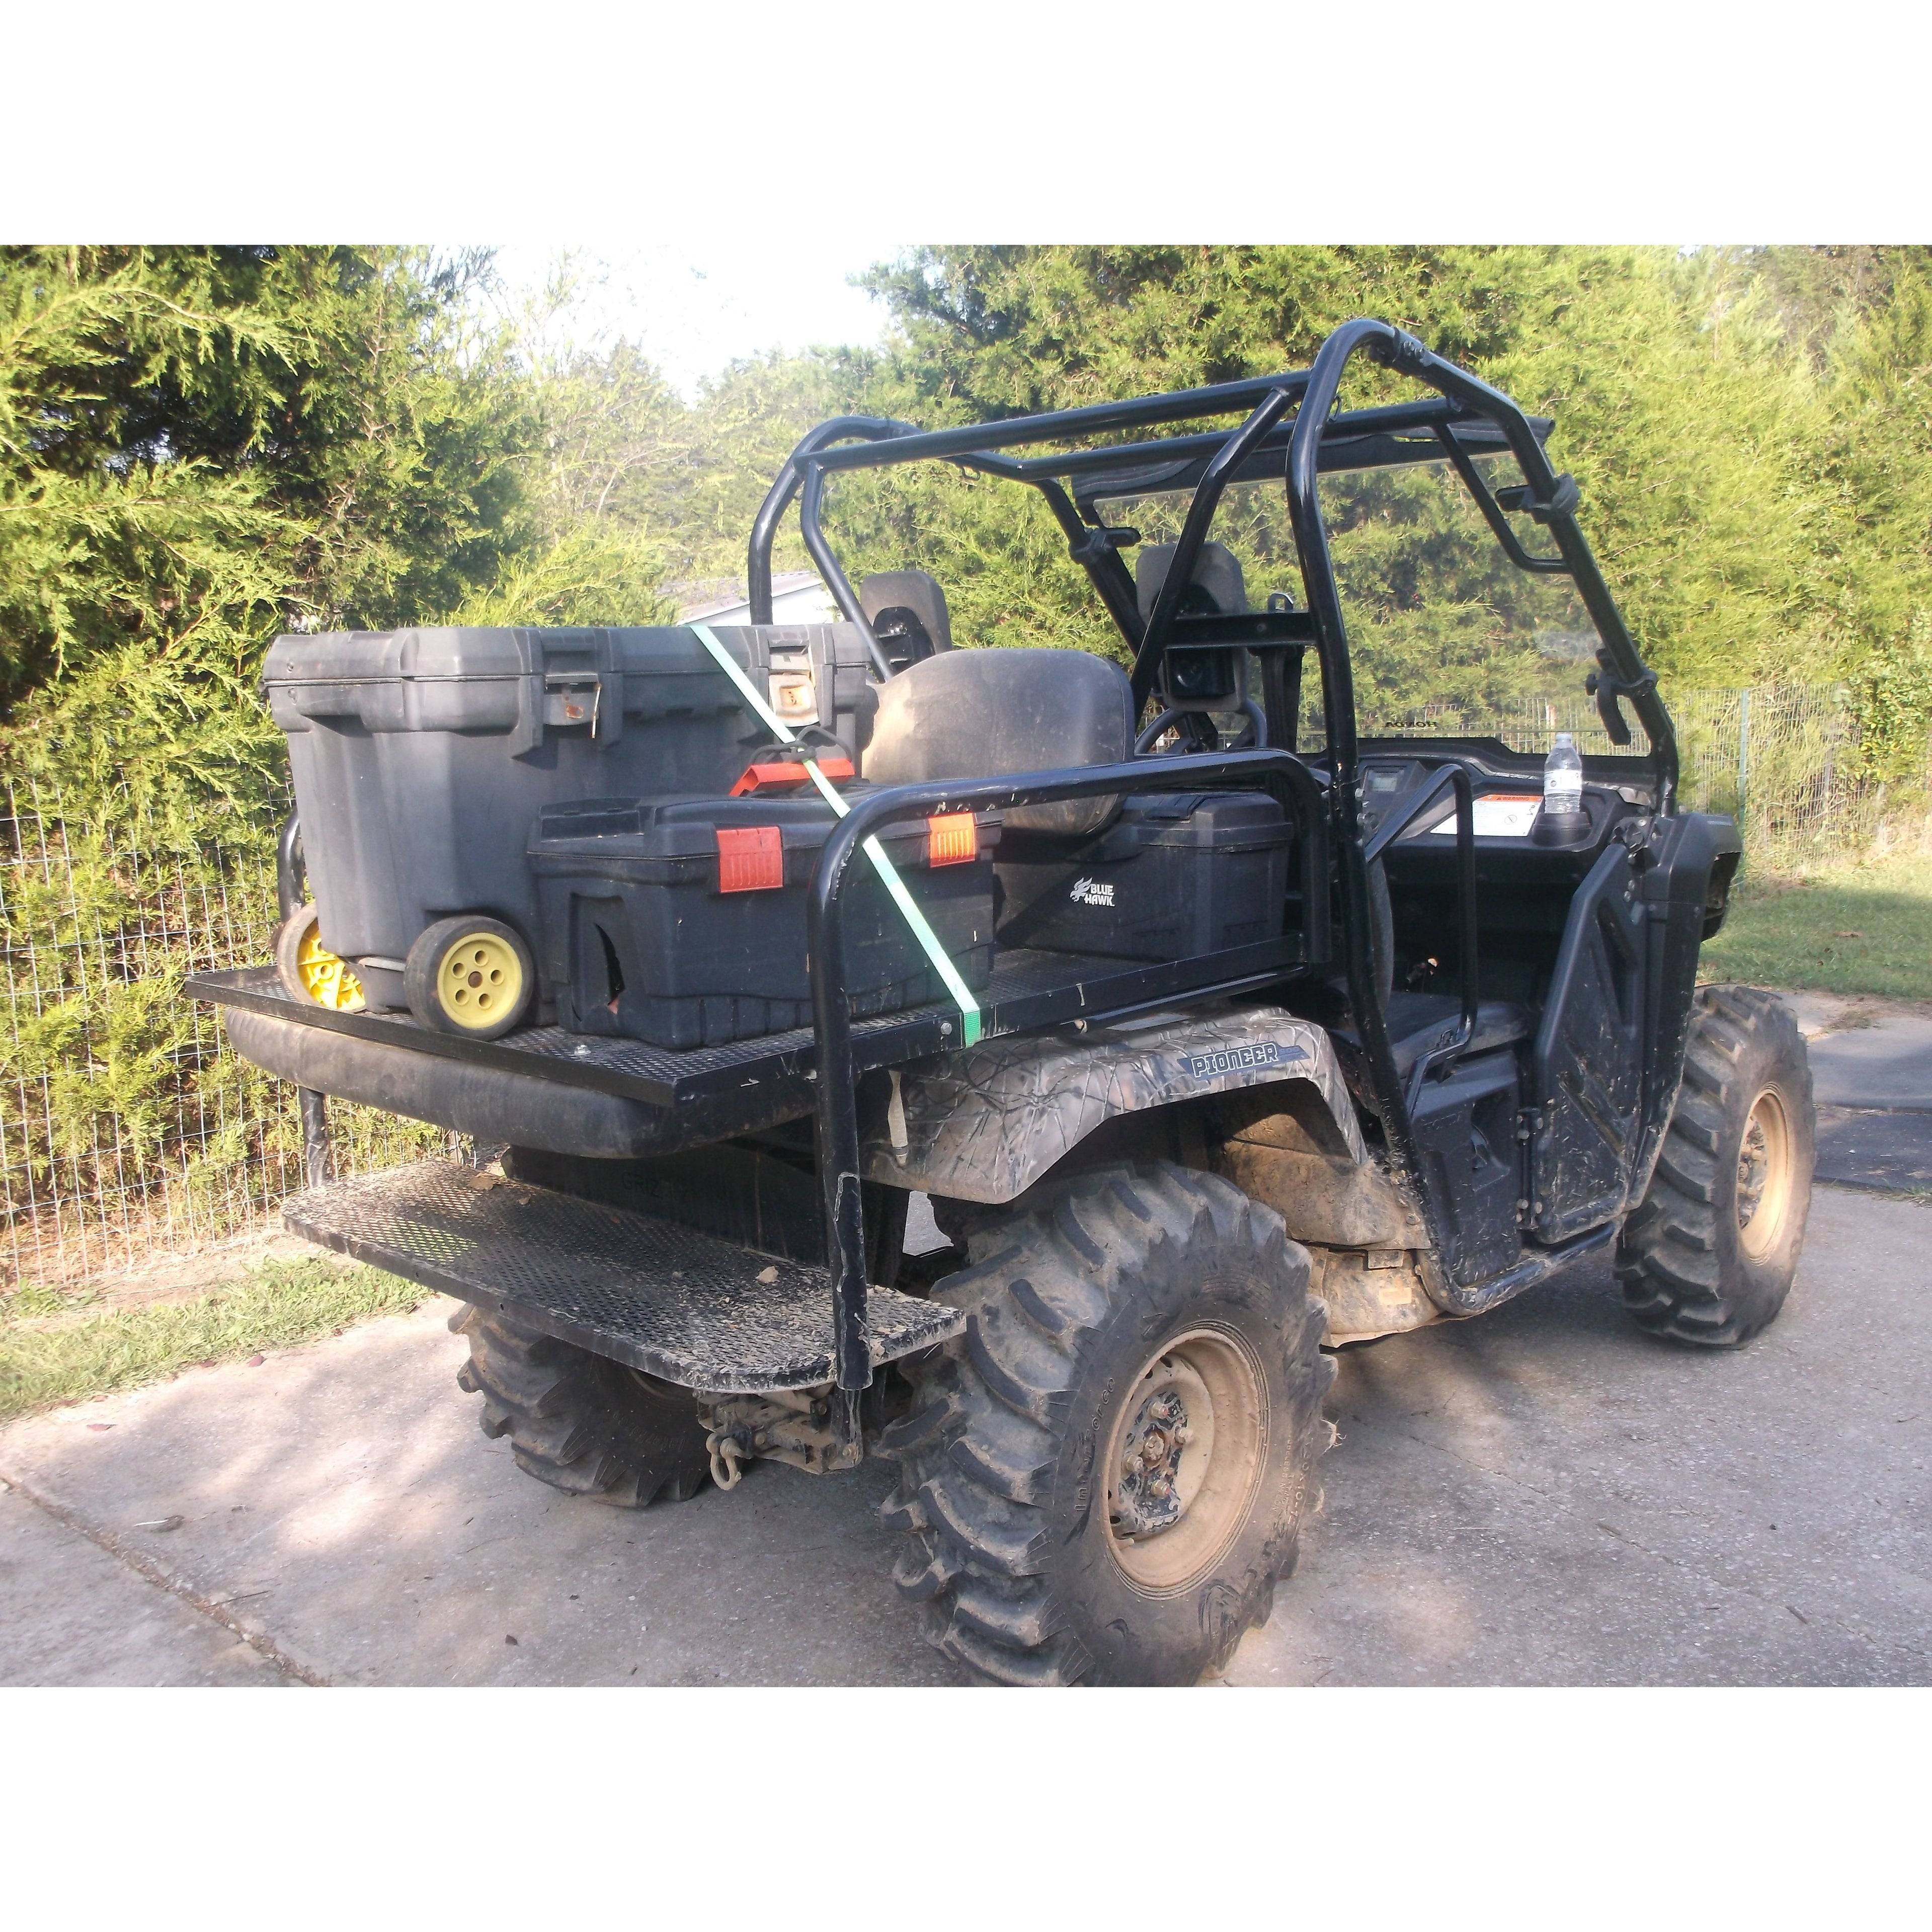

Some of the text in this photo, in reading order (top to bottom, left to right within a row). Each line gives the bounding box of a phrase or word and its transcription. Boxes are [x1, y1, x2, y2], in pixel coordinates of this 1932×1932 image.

[1090, 883, 1114, 896] BLUE
[1084, 894, 1115, 907] HAWK
[1190, 1042, 1279, 1078] PIONEER
